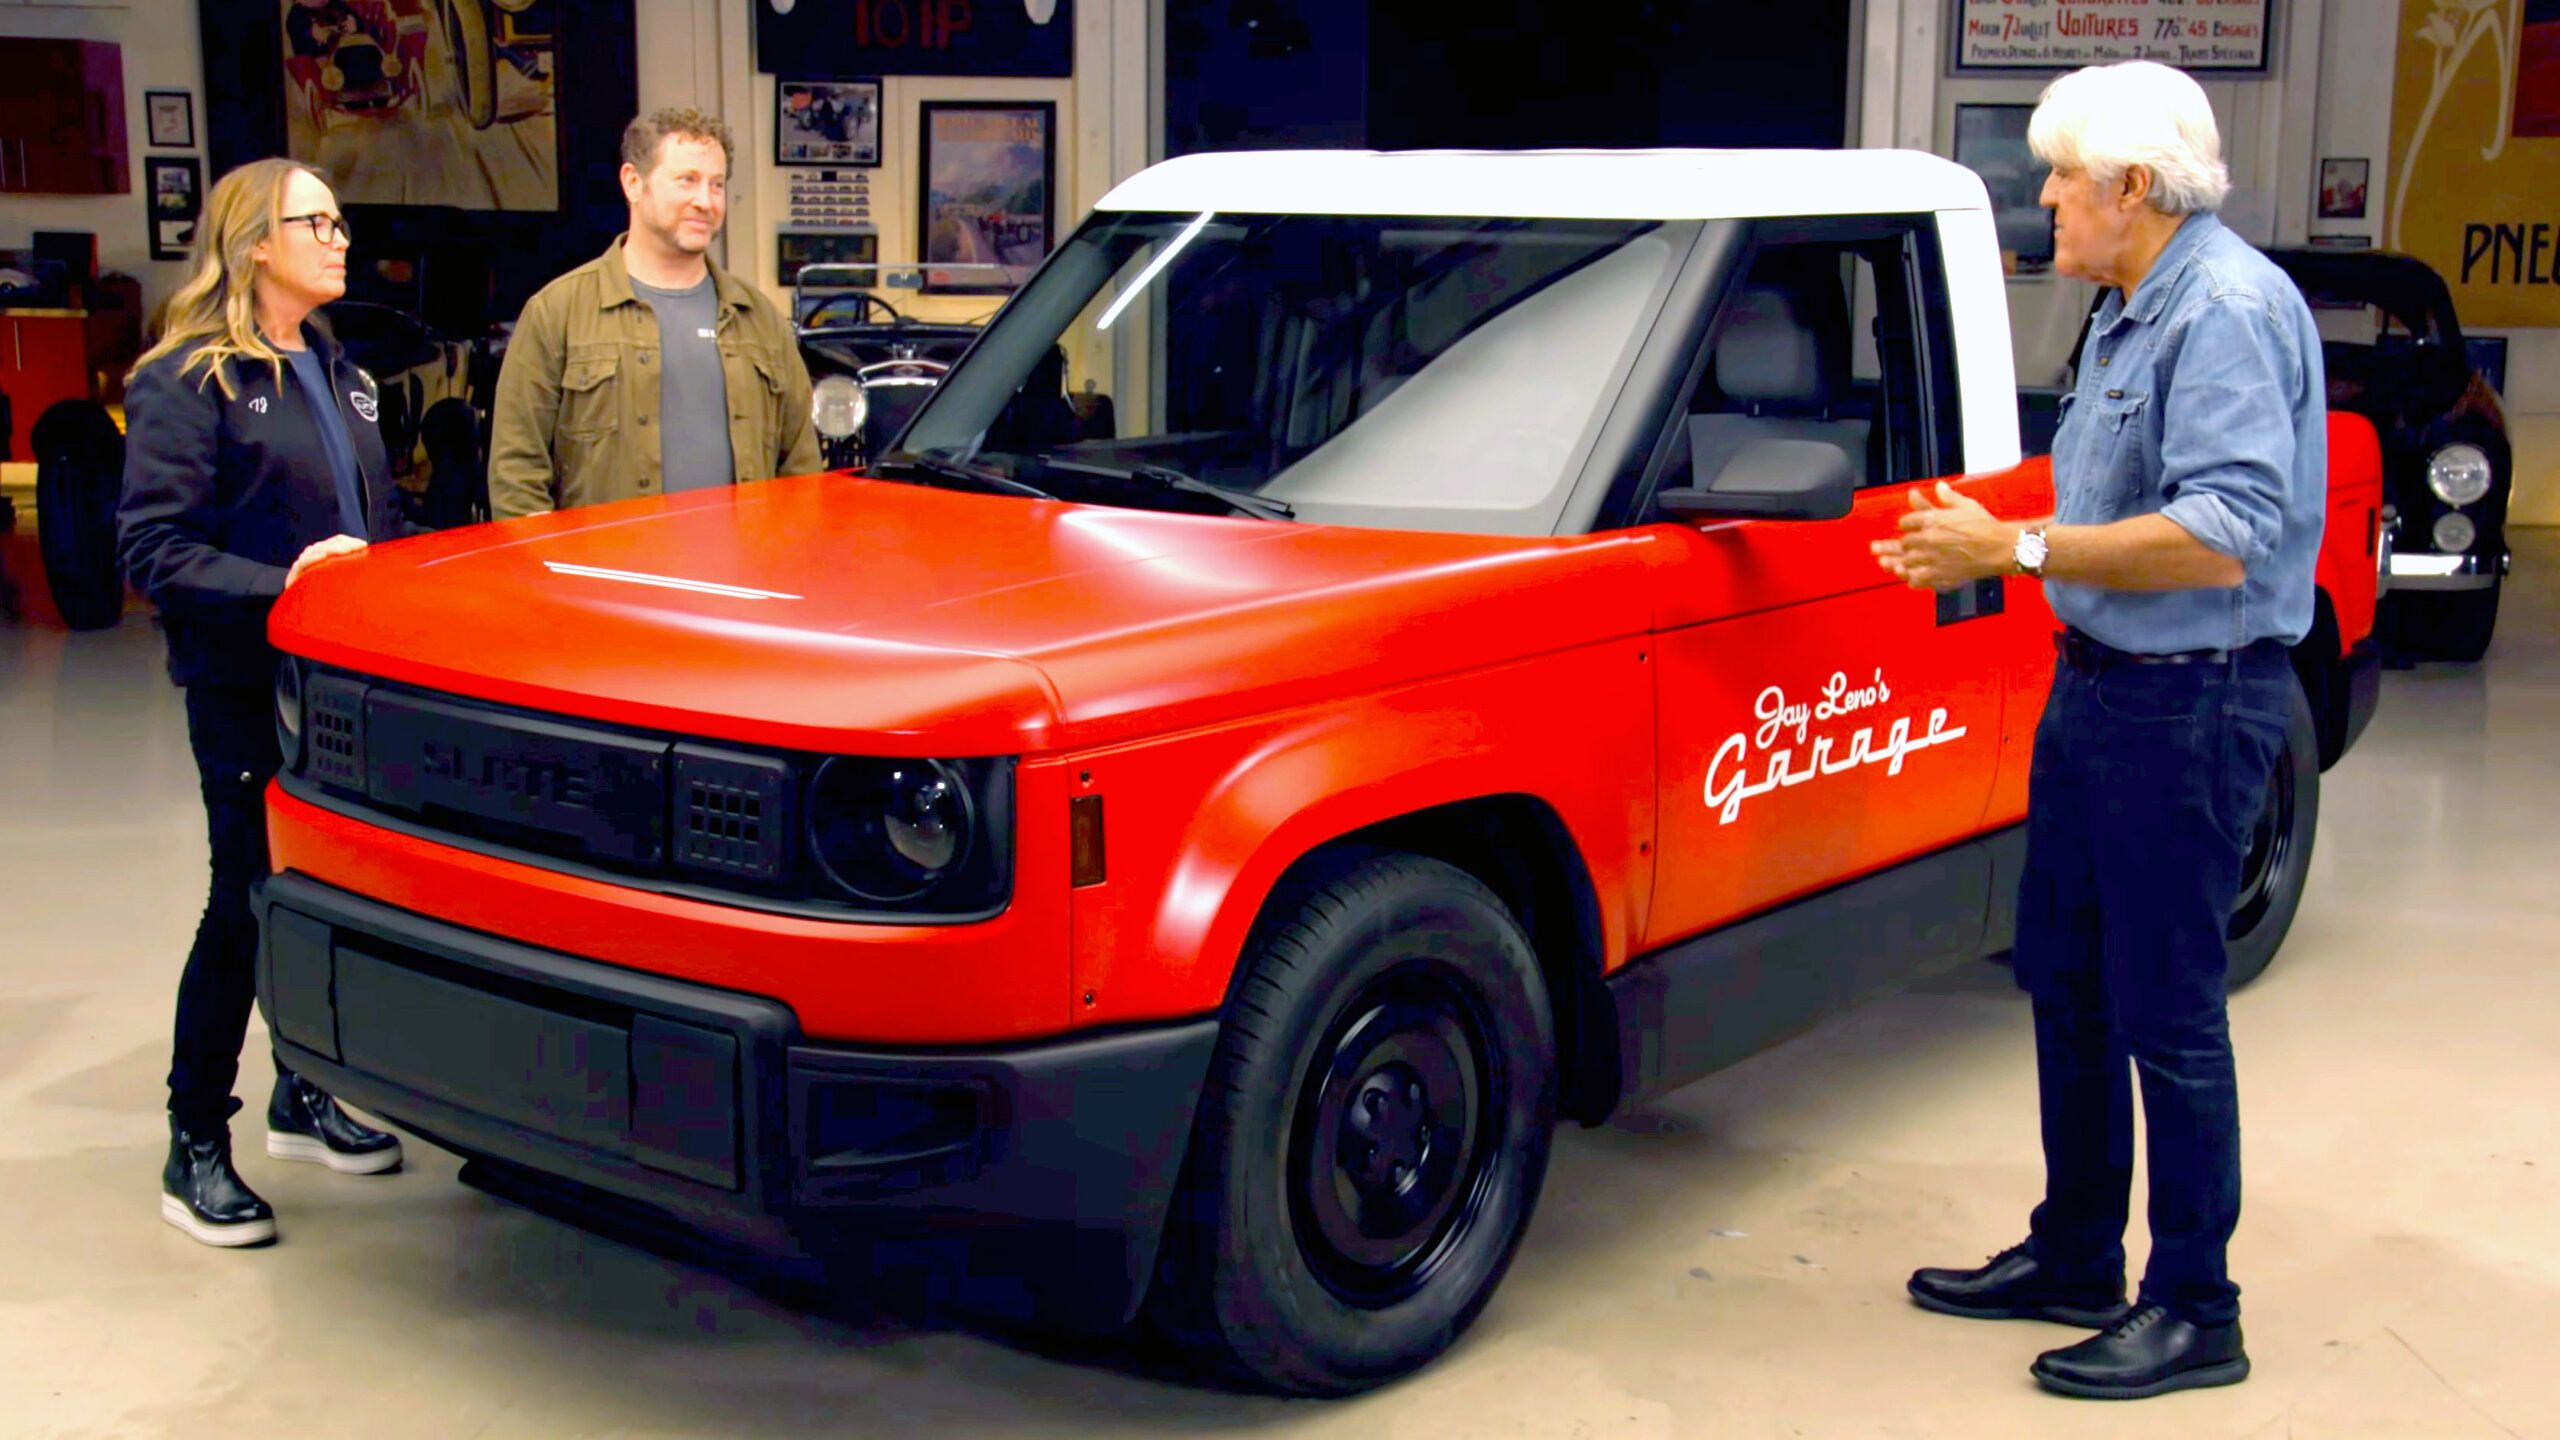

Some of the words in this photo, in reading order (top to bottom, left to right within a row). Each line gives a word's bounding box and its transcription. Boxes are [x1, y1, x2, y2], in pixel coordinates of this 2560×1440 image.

[2187, 20, 2207, 38] 45
[1755, 686, 1811, 749] Jay
[1815, 667, 1890, 720] Leno's
[1704, 707, 1967, 825] Garage
